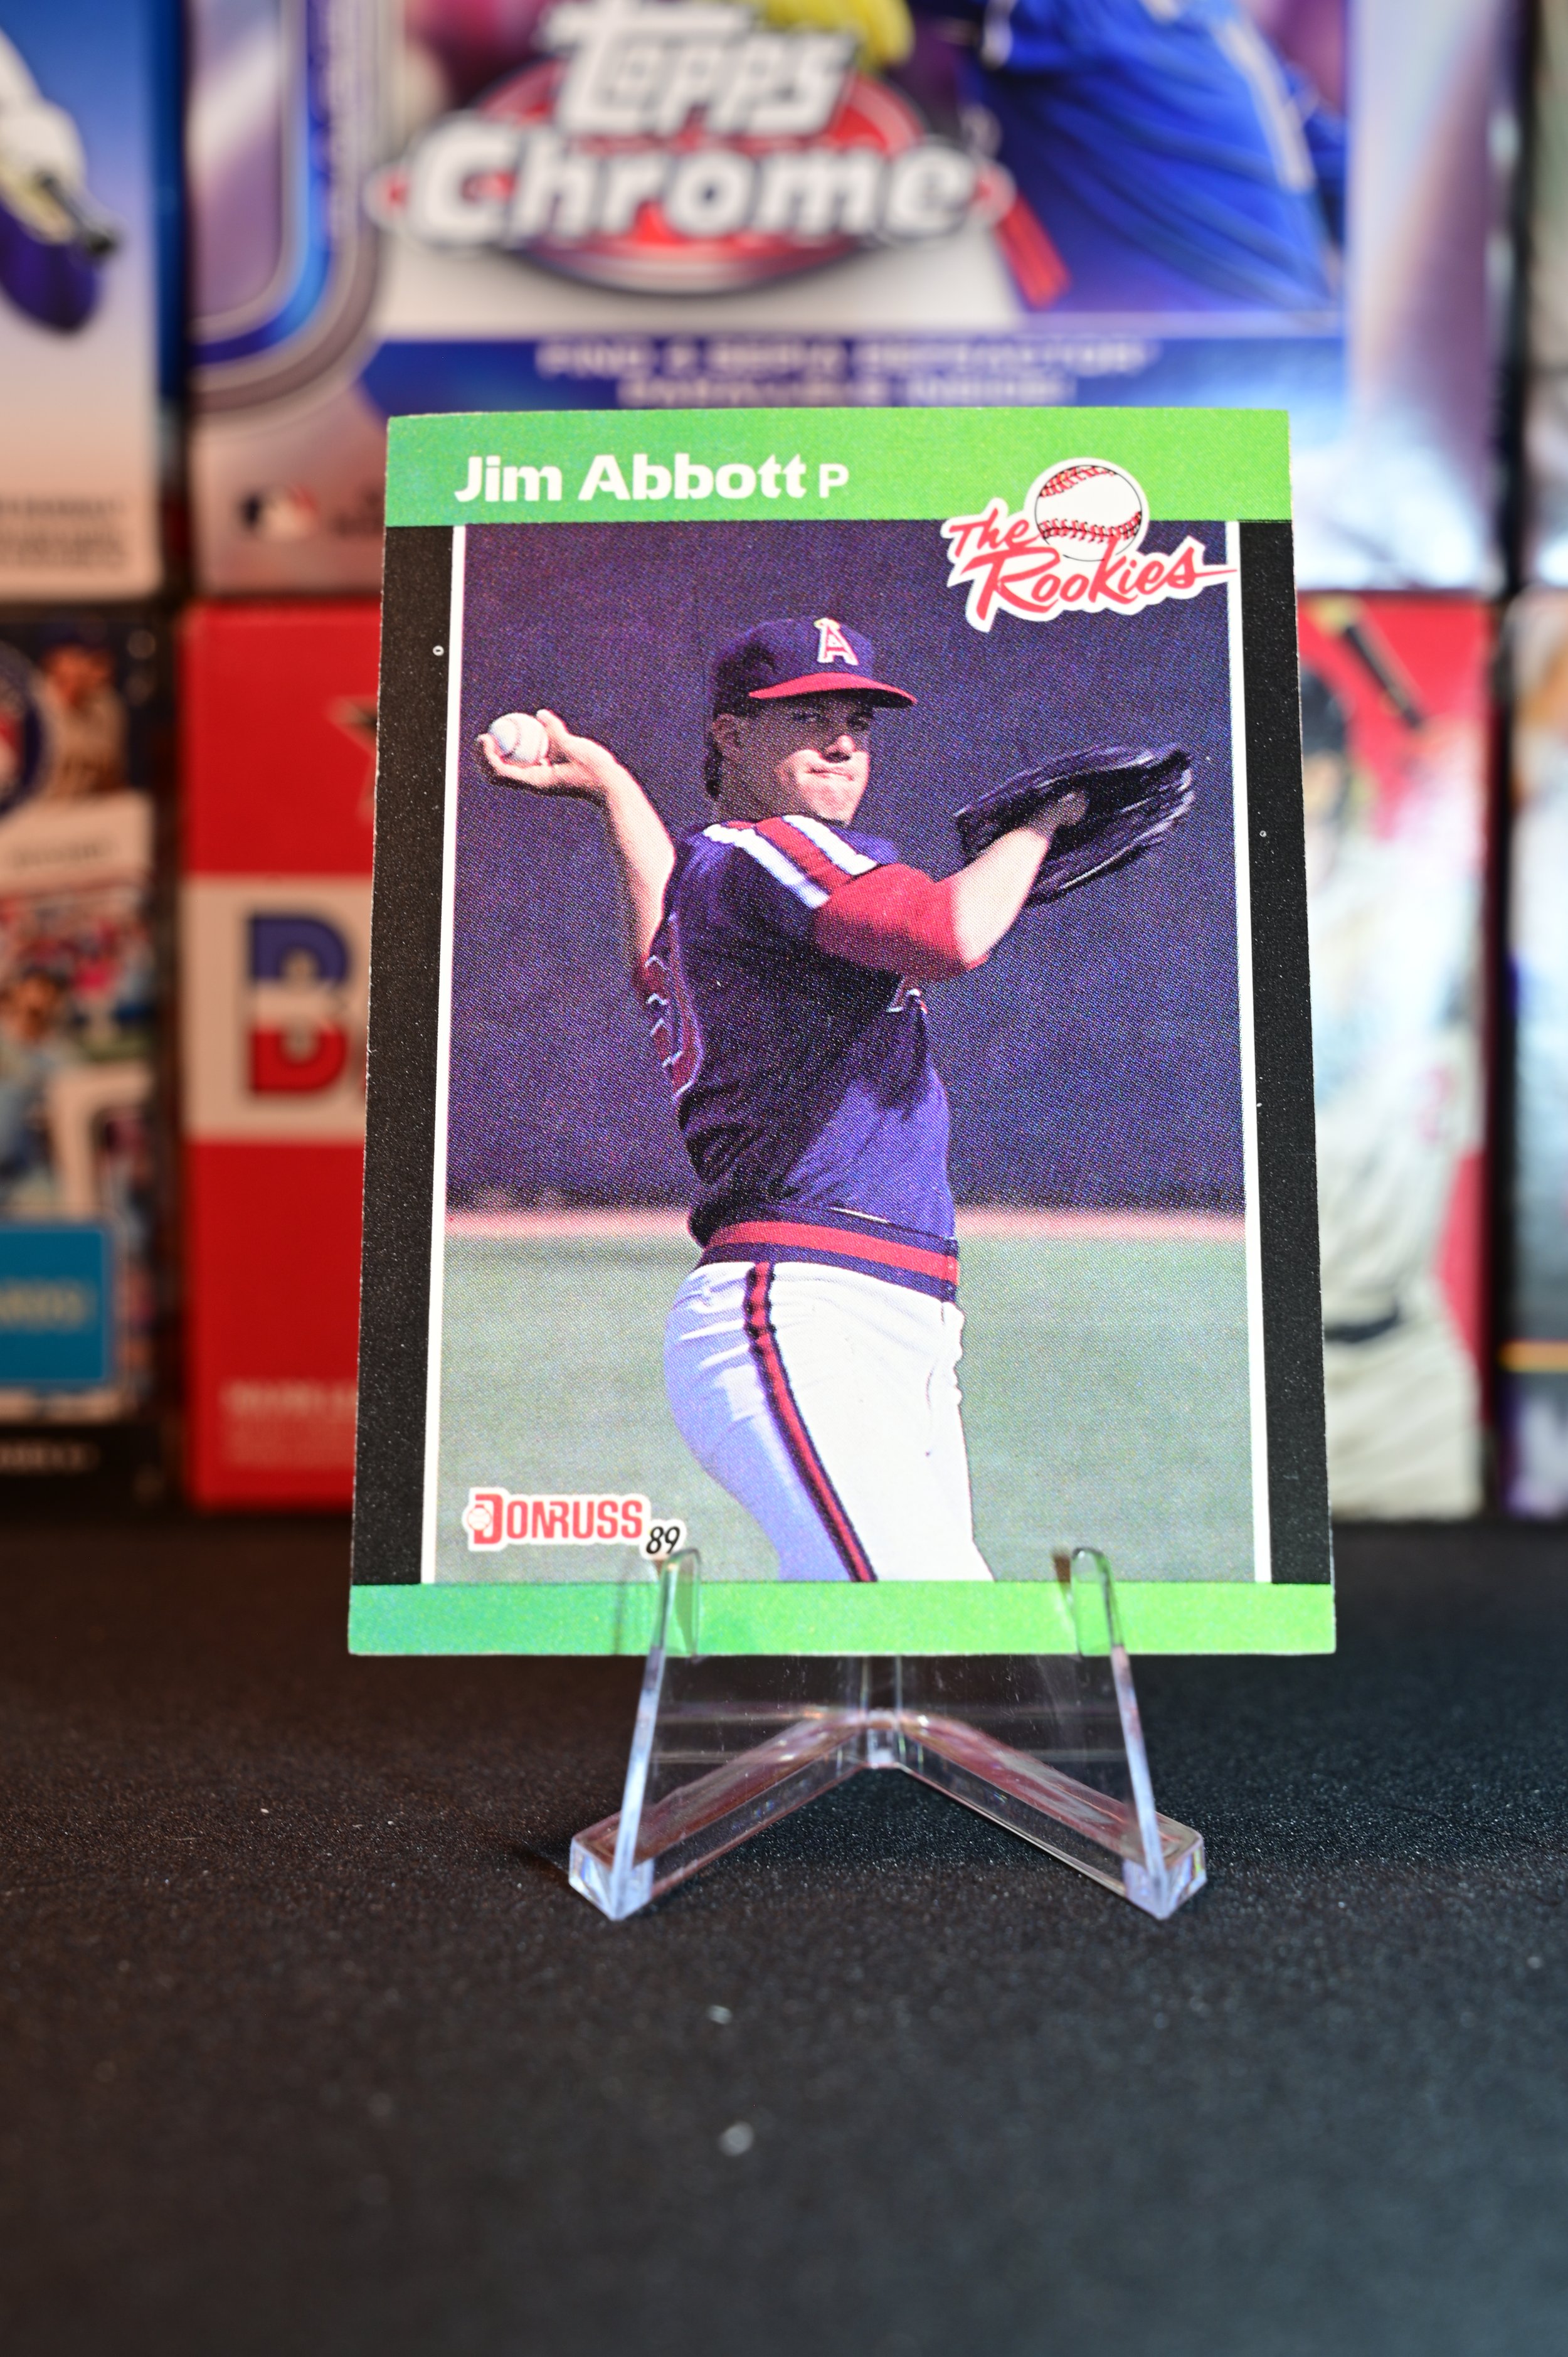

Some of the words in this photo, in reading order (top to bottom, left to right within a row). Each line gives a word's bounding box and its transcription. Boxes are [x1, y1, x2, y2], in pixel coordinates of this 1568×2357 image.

[408, 125, 975, 241] Chrome
[454, 455, 563, 503] Jim
[578, 452, 807, 501] Abbott
[819, 463, 849, 499] P
[948, 507, 1042, 558] The
[960, 533, 1238, 621] Rookies
[813, 617, 859, 666] A
[466, 1492, 644, 1545] DONRUSS
[645, 1525, 681, 1555] 89
